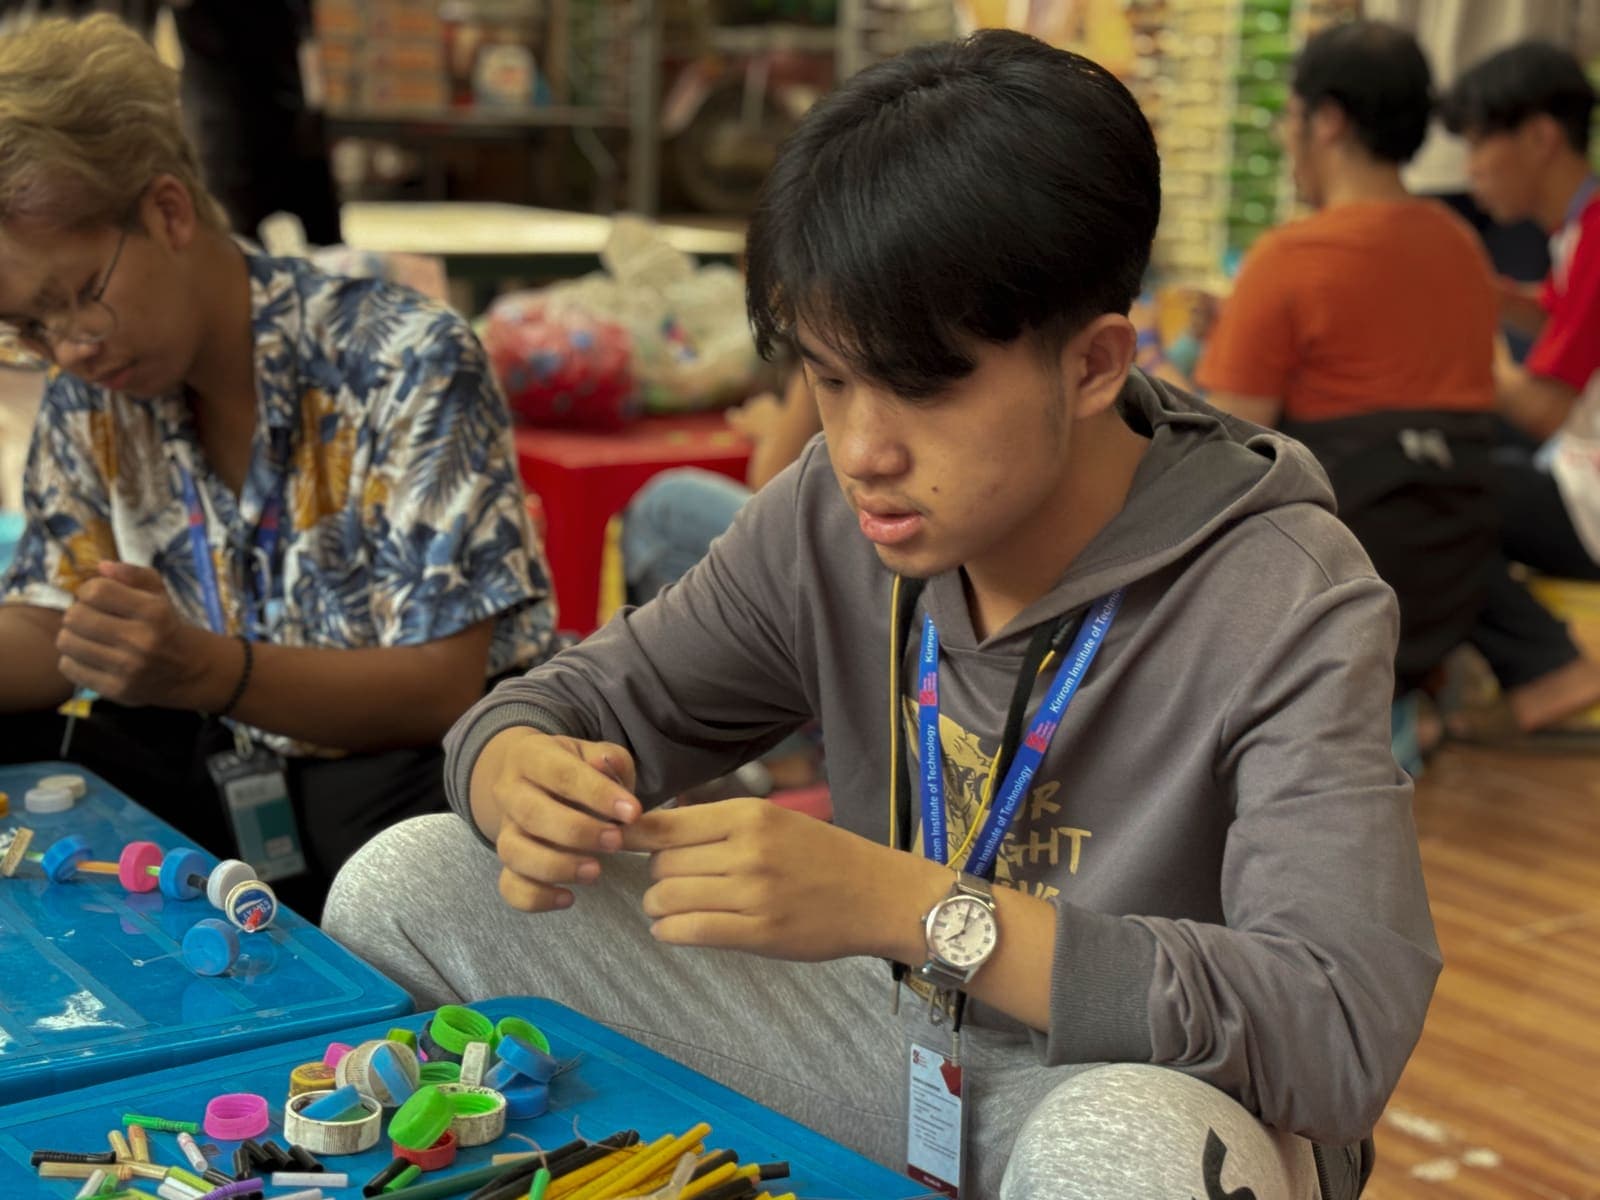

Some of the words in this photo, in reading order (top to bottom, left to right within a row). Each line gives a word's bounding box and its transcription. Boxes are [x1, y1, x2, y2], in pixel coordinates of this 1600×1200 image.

[1049, 676, 1076, 713] Kirirom
[1068, 638, 1096, 679] Institute
[1091, 625, 1102, 638] of
[926, 723, 937, 781] Technology
[927, 783, 938, 794] of
[999, 765, 1033, 816] Technology
[930, 796, 941, 836] Institute
[997, 815, 1008, 828] of
[978, 827, 1002, 862] Institute
[1001, 827, 1092, 875] GHT
